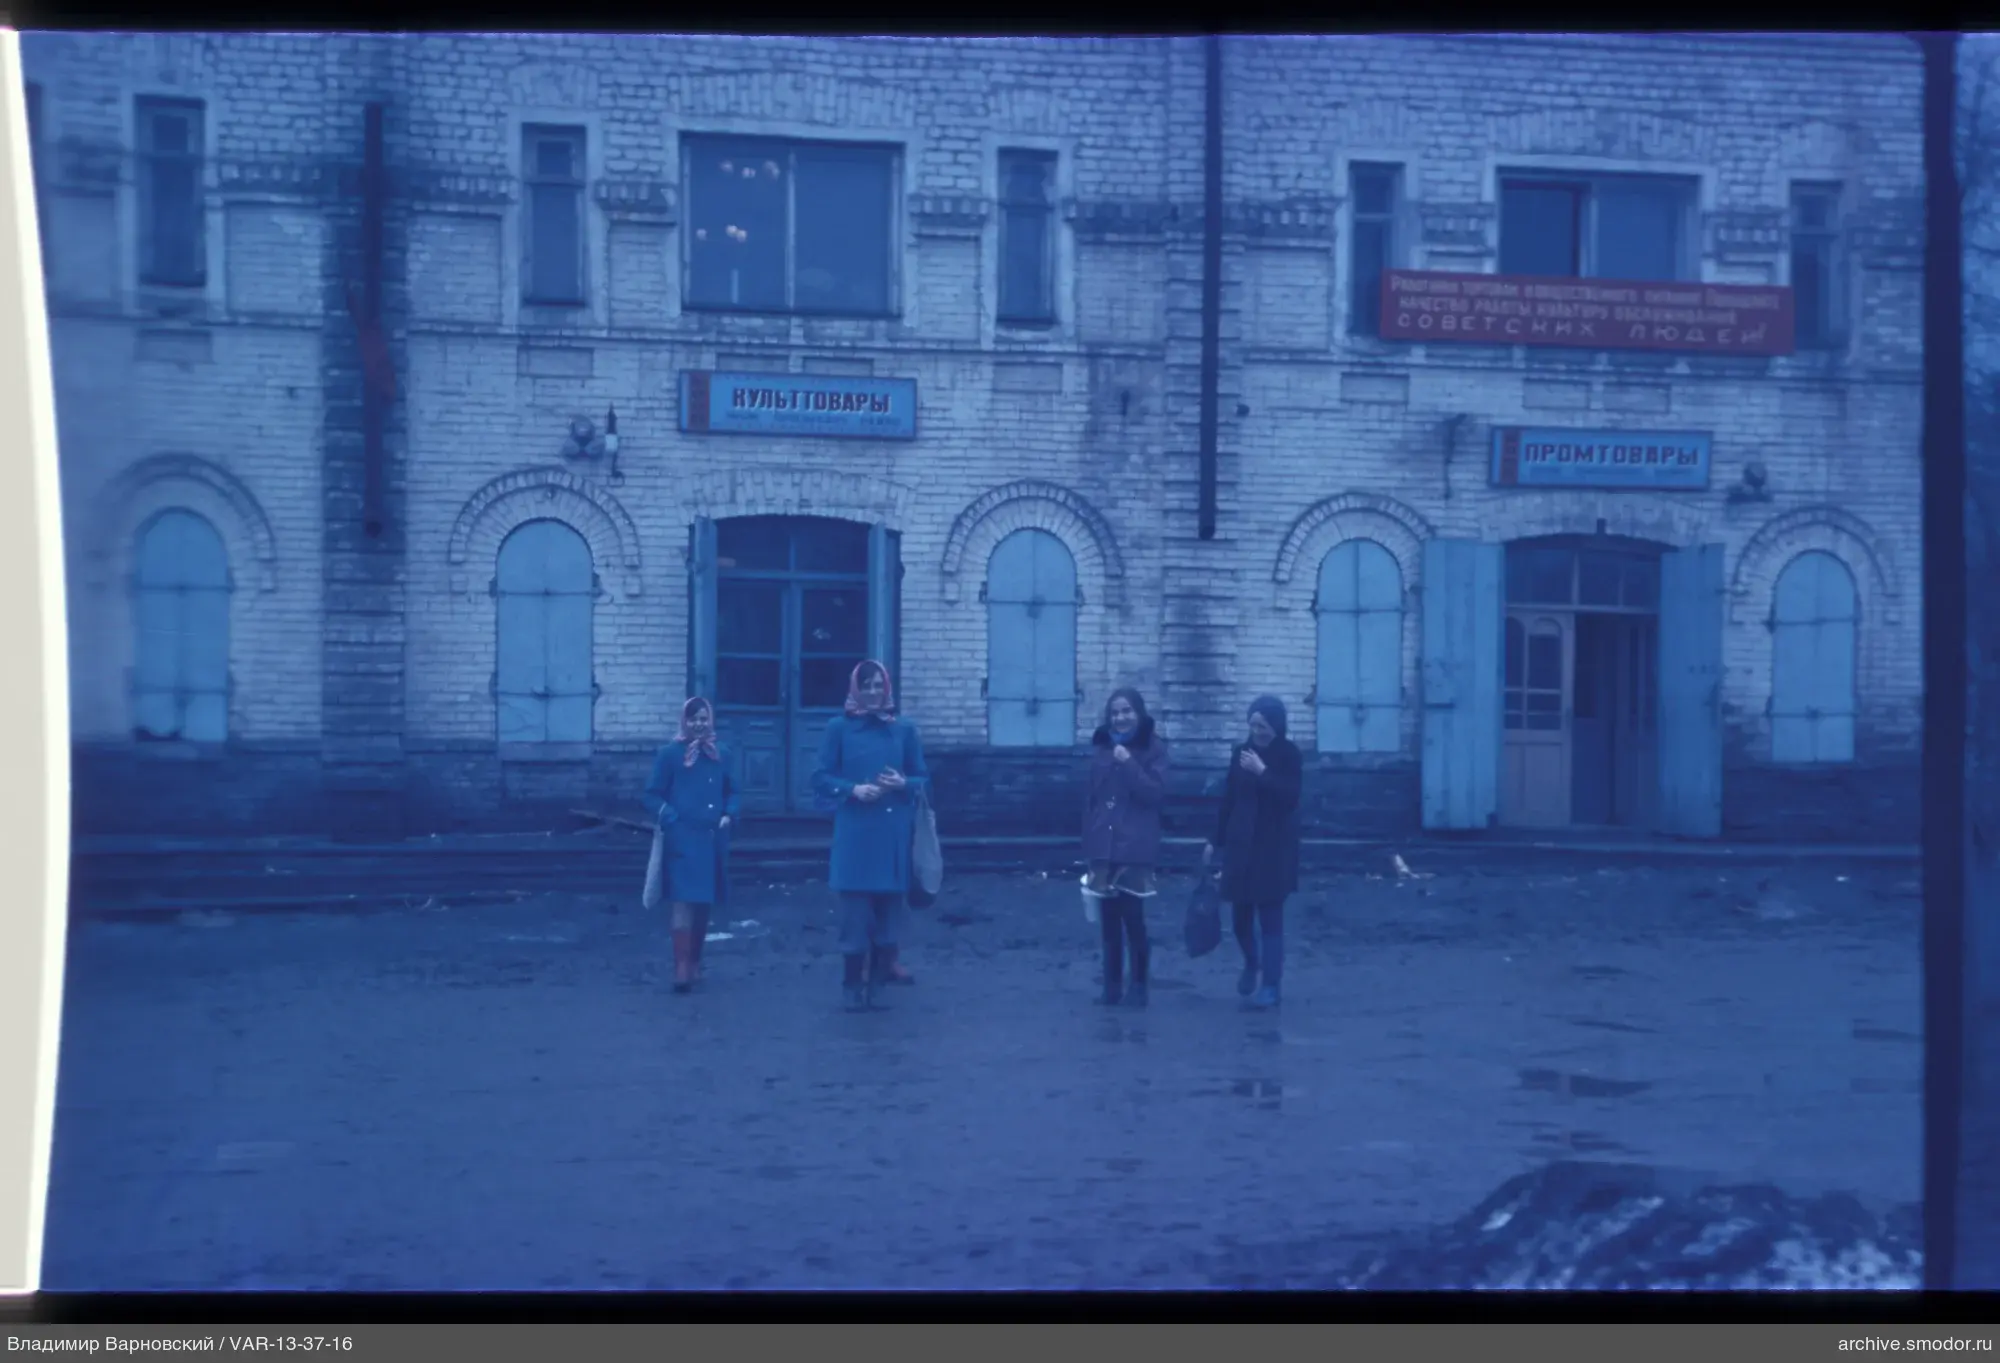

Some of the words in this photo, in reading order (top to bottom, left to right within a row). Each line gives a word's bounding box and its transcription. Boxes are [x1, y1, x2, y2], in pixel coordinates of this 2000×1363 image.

[1398, 312, 1596, 338] СОВЕТСКИХ
[732, 387, 892, 414] КУЛЬТТОВАРЫ
[1524, 443, 1699, 466] ПРОМТОВАРЫ
